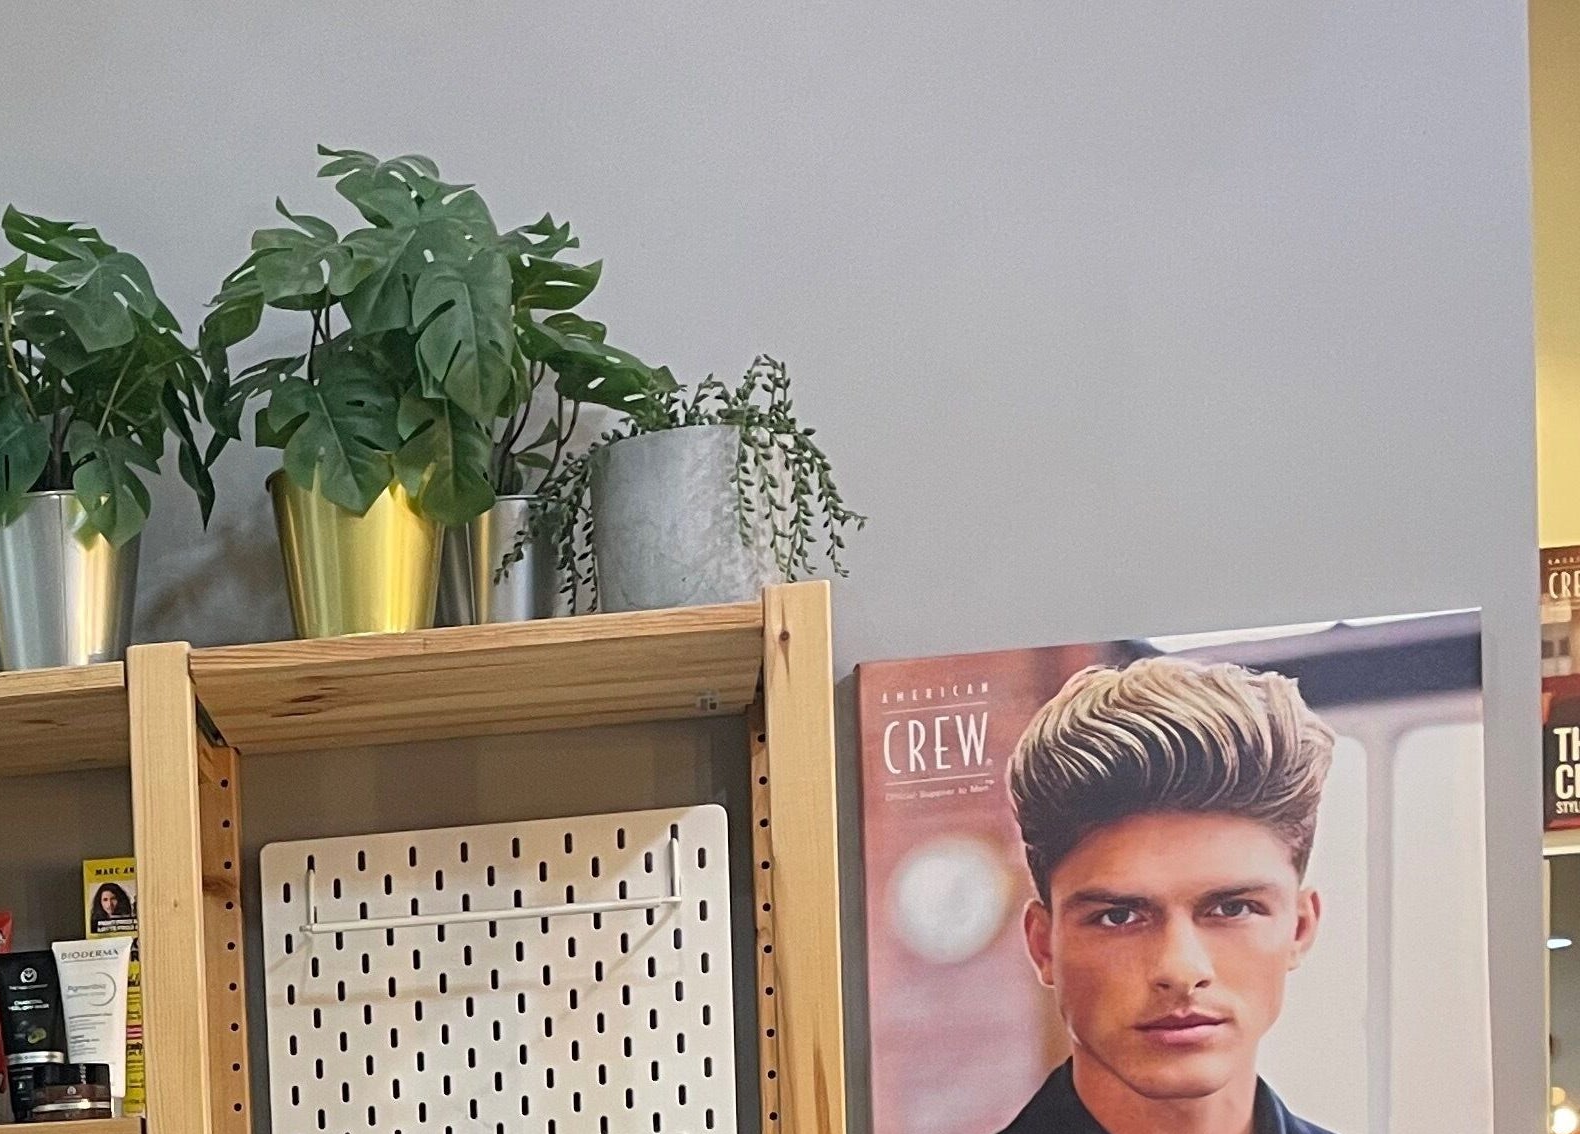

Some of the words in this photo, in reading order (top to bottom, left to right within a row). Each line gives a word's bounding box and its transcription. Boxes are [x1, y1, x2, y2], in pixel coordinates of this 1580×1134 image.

[881, 682, 988, 704] AMERICAN
[883, 711, 988, 774] CREW
[61, 949, 119, 960] BIODERMA
